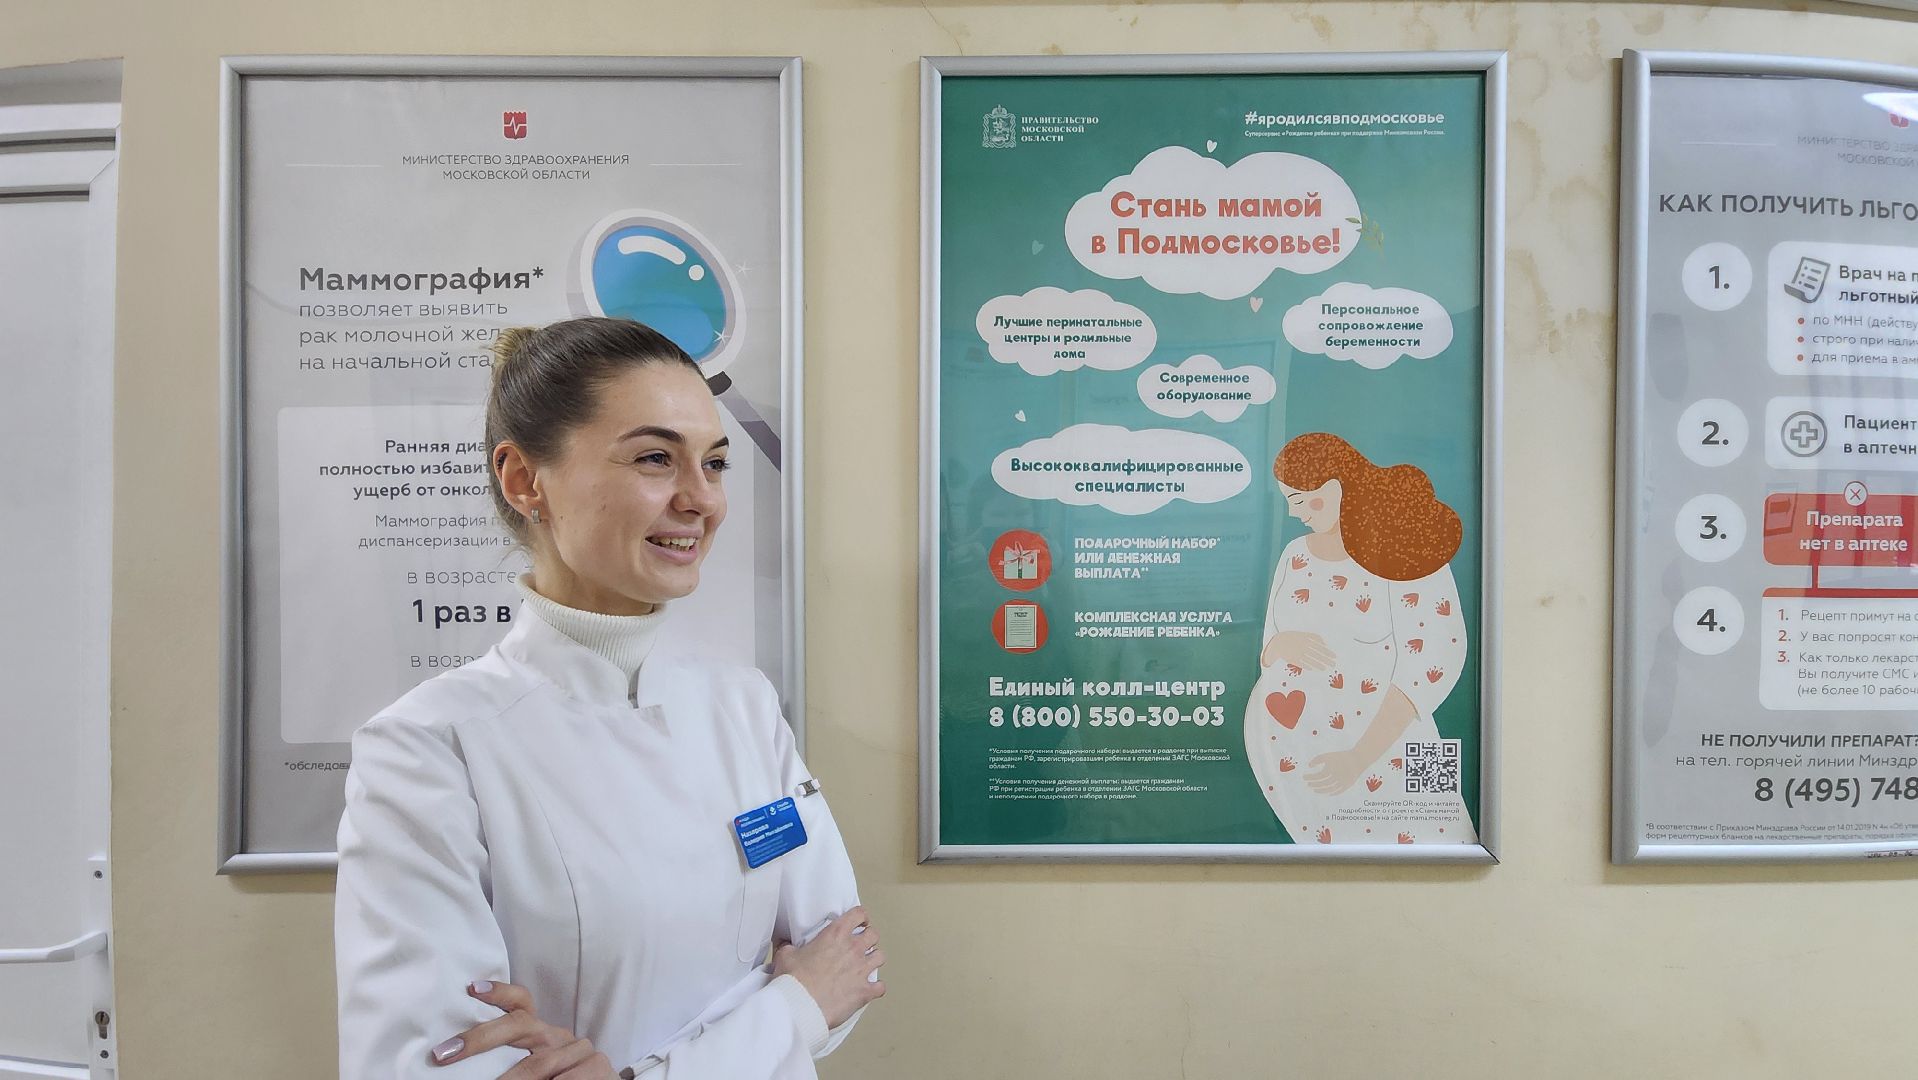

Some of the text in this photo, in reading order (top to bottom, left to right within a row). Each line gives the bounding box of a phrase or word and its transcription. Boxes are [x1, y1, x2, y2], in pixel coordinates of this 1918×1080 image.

[1021, 116, 1099, 124] ПРАВИТЕЛЬСТВО
[1244, 111, 1445, 128] #яродилсявподмосковье
[1021, 125, 1085, 133] МОСКОВСКОЙ
[1797, 136, 1889, 151] МИНИСТЕРСТВО
[402, 153, 630, 166] МИНИСТЕРСТВО ЗДРАВООХРАНЕНИЯ
[1837, 152, 1915, 168] МОСКОВСКОЙ
[442, 167, 591, 181] МОСКОВСКОЙ ОБЛАСТИ
[1110, 190, 1322, 218] Стань мамой
[1659, 194, 1918, 221] КАК ПОЛУЧИТЬ ЛЬГО
[1091, 227, 1341, 257] в Подмосковье!
[1708, 265, 1730, 290] 1.
[1839, 265, 1883, 282] Врач
[1887, 270, 1906, 282] на
[1838, 290, 1918, 304] льготный
[299, 303, 508, 317] позволяет выявить
[1321, 303, 1420, 317] Персональное
[993, 315, 1143, 331] Лучшие перинатальные
[1318, 320, 1424, 335] сопровождение
[1813, 315, 1918, 331] по МНН (действу
[299, 331, 338, 347] рак
[345, 325, 453, 343] молочной
[1004, 332, 1132, 347] центры и родильные
[1325, 334, 1421, 349] беременности
[1812, 335, 1884, 347] строго при
[299, 352, 451, 370] на начальной
[1053, 349, 1086, 361] дома
[1811, 353, 1898, 364] для приема в
[1159, 372, 1250, 386] Современное
[1156, 388, 1252, 403] оборудование
[1844, 415, 1918, 431] Пациент
[1701, 420, 1729, 445] 2.
[385, 439, 450, 453] Ранняя
[1843, 441, 1918, 455] в аптечн
[319, 464, 416, 476] полностью
[1010, 458, 1244, 475] Высококвалифицированные
[353, 483, 411, 500] ущерб
[416, 486, 435, 496] от
[1074, 478, 1186, 494] специалисты
[375, 514, 487, 529] Маммография
[1806, 510, 1904, 528] Препарата
[1699, 515, 1727, 540] 3.
[358, 537, 511, 550] диспансеризации в
[1074, 535, 1171, 549] ПОДАРОЧНЫЙ
[1800, 538, 1908, 554] нет в аптеке
[1074, 552, 1181, 564] ИЛИ ДЕНЕЖНАЯ
[407, 571, 517, 588] в возрасте
[412, 599, 511, 629] 1 раз в
[1074, 611, 1233, 623] КОМПЛЕКСНАЯ УСЛУГА
[1696, 608, 1727, 633] 4.
[1777, 608, 1789, 621] 1.
[1801, 609, 1847, 622] Рецепт
[1850, 613, 1895, 623] примут
[1897, 613, 1911, 621] на
[1075, 626, 1221, 638] «РОЖДЕНИЕ РЕБЕНКА»
[1777, 629, 1792, 642] 2.
[1800, 631, 1809, 642] У
[1812, 633, 1834, 642] вас
[1838, 633, 1897, 644] попросят
[410, 655, 422, 668] в
[1777, 650, 1790, 663] 3.
[1799, 652, 1823, 663] Как
[1825, 655, 1869, 663] только
[1798, 669, 1817, 679] Вы
[1821, 671, 1879, 681] получите
[1882, 669, 1910, 679] СМС
[988, 676, 1226, 701] Единый колл-центр
[1797, 684, 1818, 698] (не
[1821, 685, 1859, 695] более
[1862, 684, 1876, 695] 10
[988, 704, 1225, 729] 8 (800) 550-30-03
[1701, 733, 1725, 747] НЕ
[1728, 734, 1826, 748] ПОЛУЧИЛИ
[1675, 752, 1918, 771] на тел. горячей линии Минздр
[1754, 777, 1918, 808] 8 (495) 748
